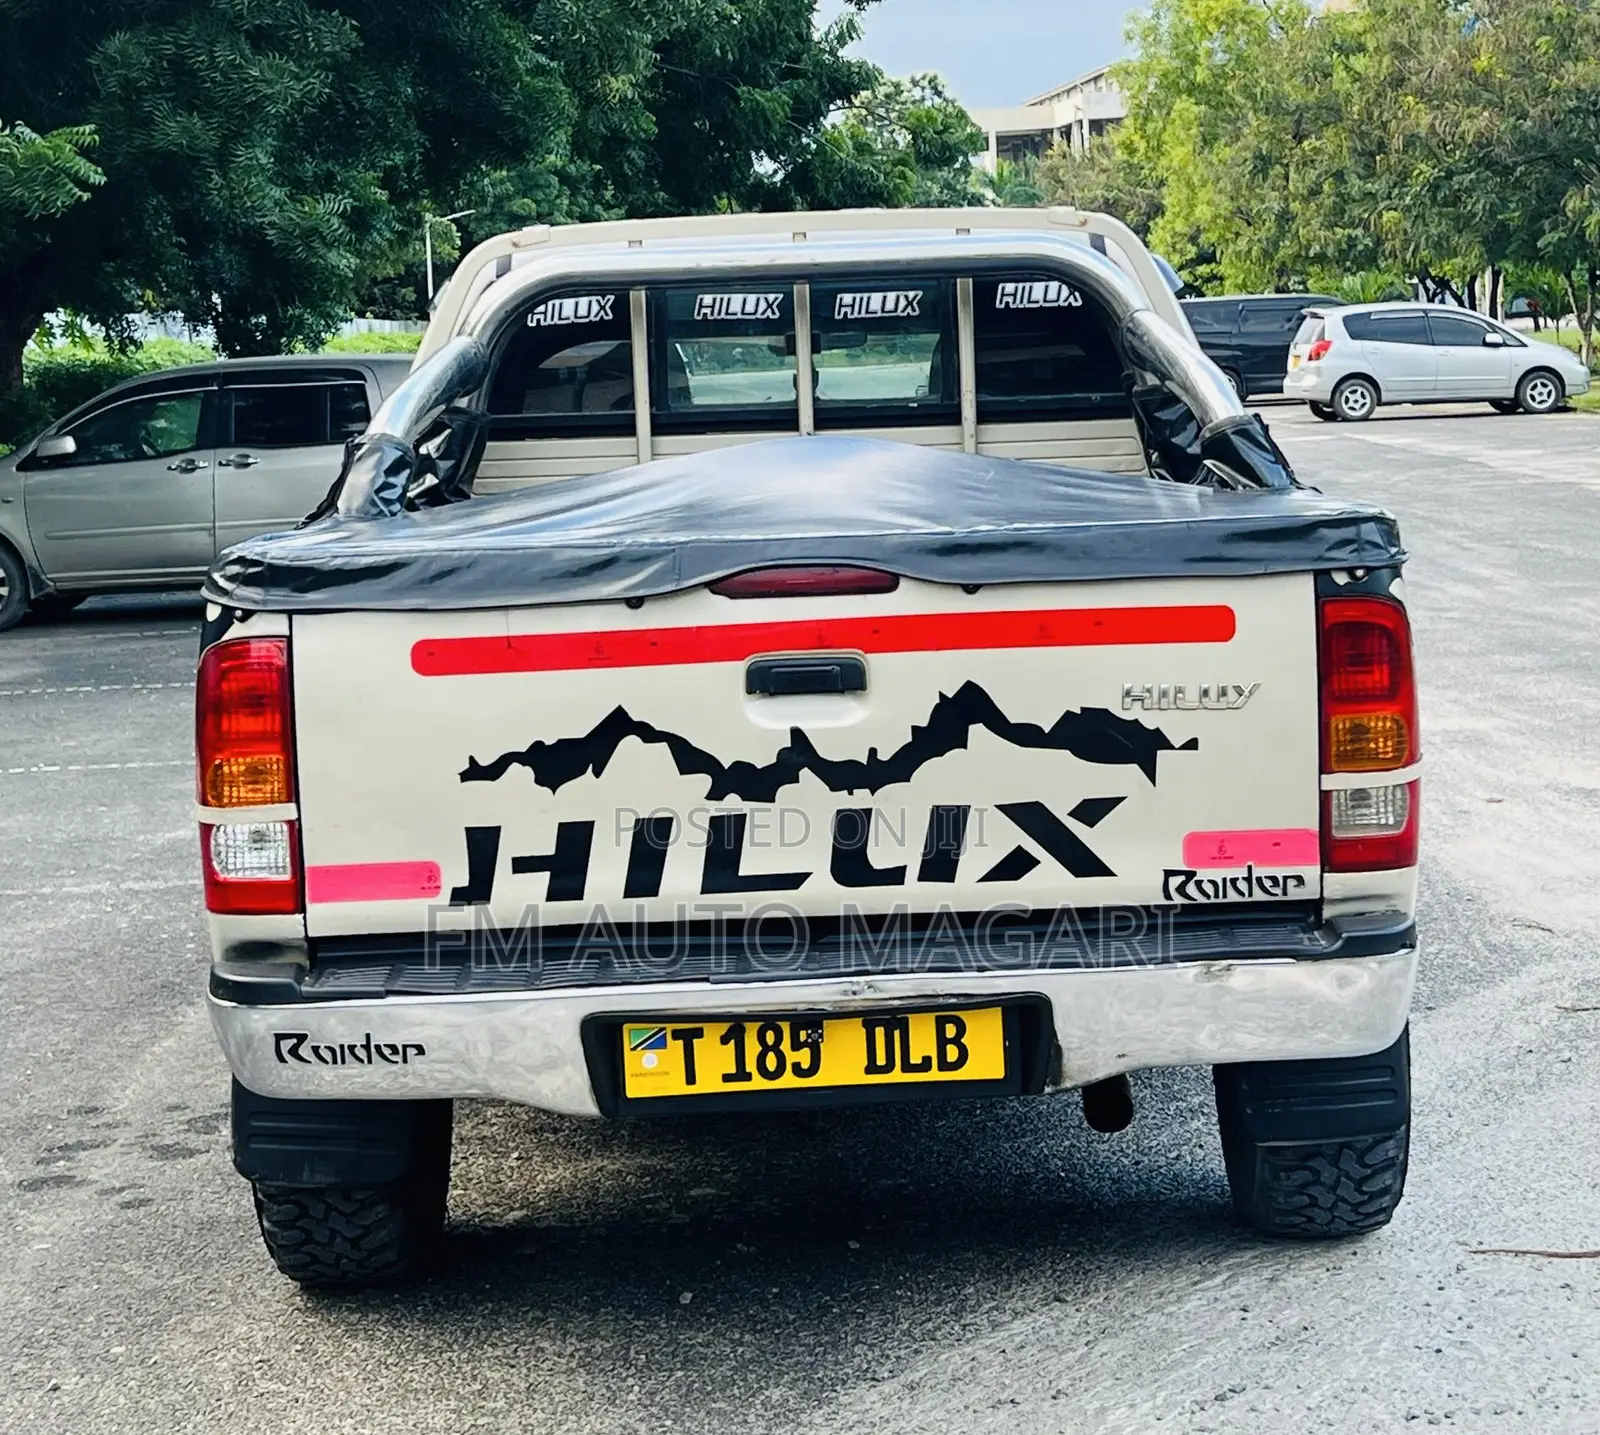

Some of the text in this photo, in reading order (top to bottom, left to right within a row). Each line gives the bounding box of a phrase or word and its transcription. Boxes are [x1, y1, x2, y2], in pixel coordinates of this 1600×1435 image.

[694, 293, 784, 320] HILUX
[834, 290, 923, 319] HILUX
[996, 281, 1082, 308] HILUX
[527, 295, 615, 327] HILUX
[449, 796, 1128, 907] HILUX
[1162, 865, 1306, 901] Raider
[273, 1032, 427, 1065] Raider
[671, 1014, 969, 1086] T 185 DLB
